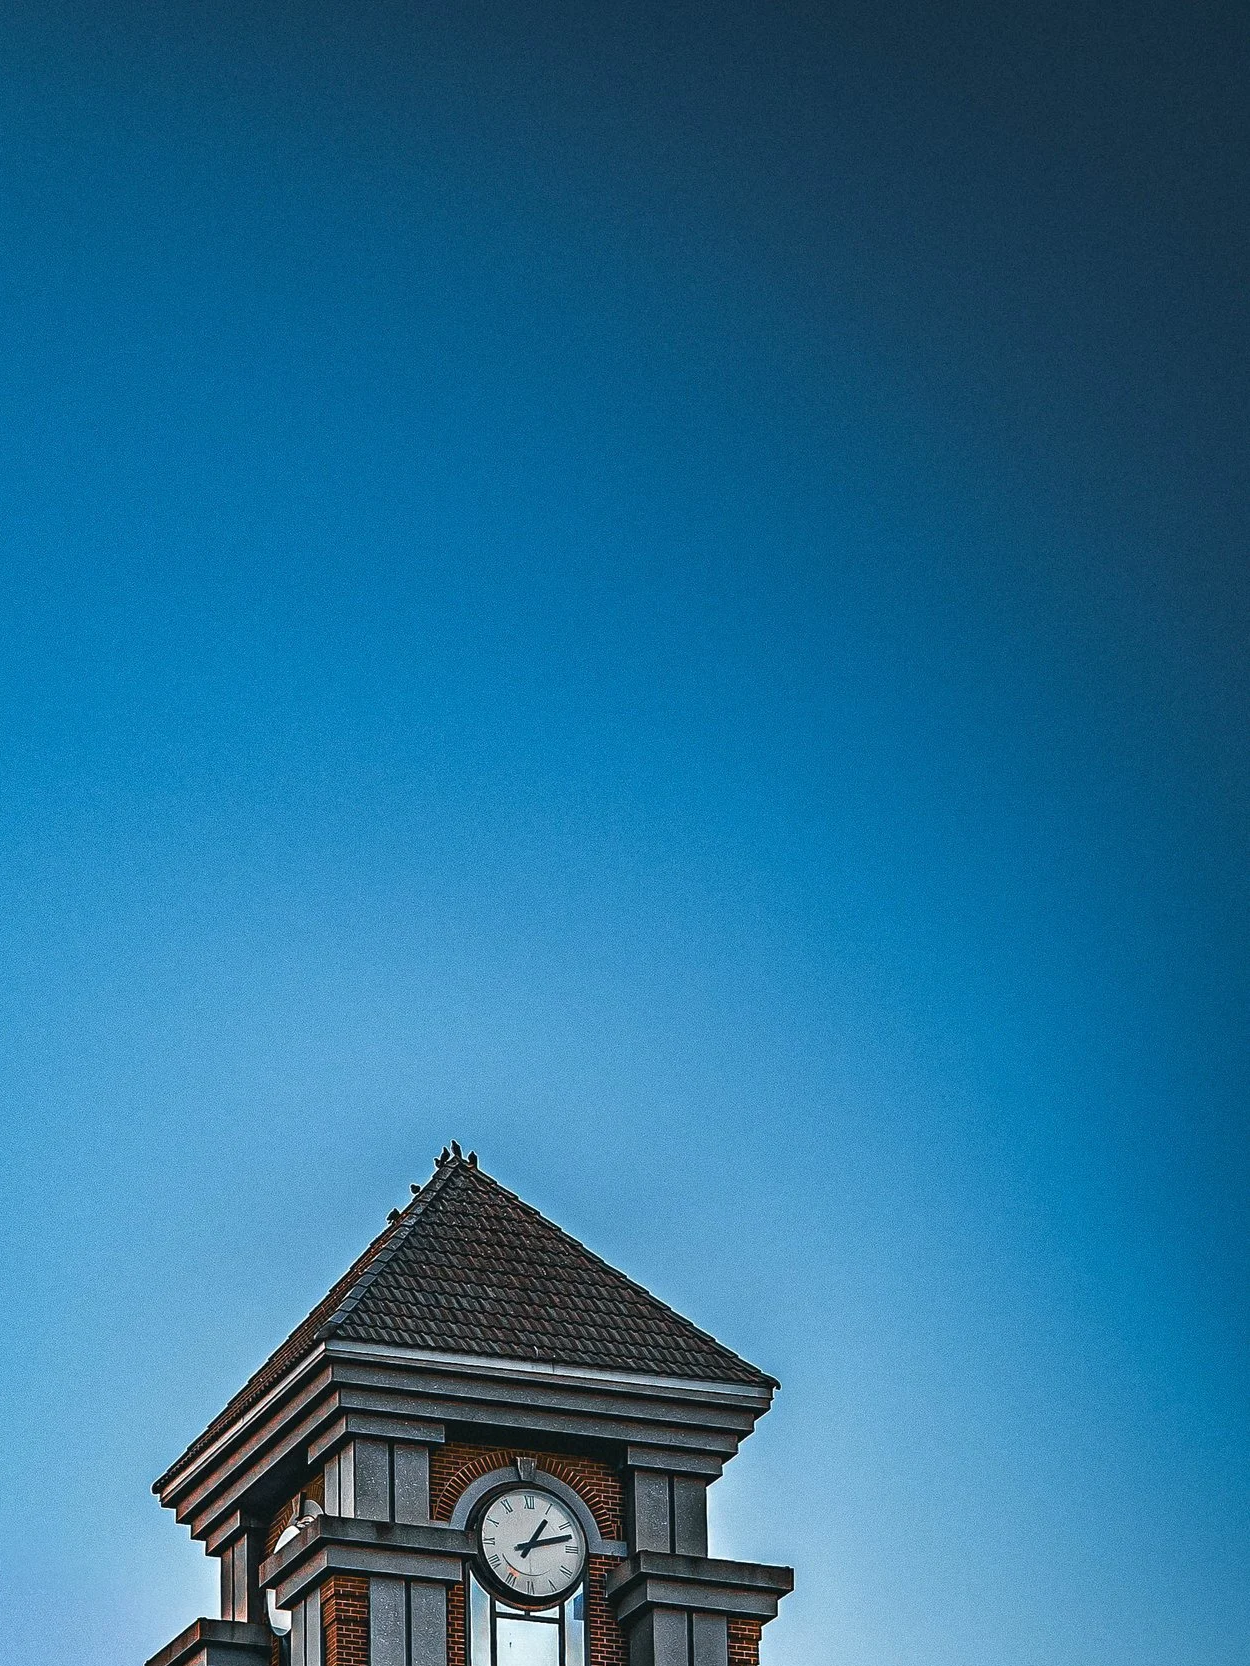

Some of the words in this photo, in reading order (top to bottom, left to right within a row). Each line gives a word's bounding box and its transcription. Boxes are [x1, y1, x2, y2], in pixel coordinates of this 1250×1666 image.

[500, 1499, 514, 1514] XI
[523, 1495, 535, 1510] XII
[558, 1521, 571, 1531] II
[565, 1545, 579, 1554] III
